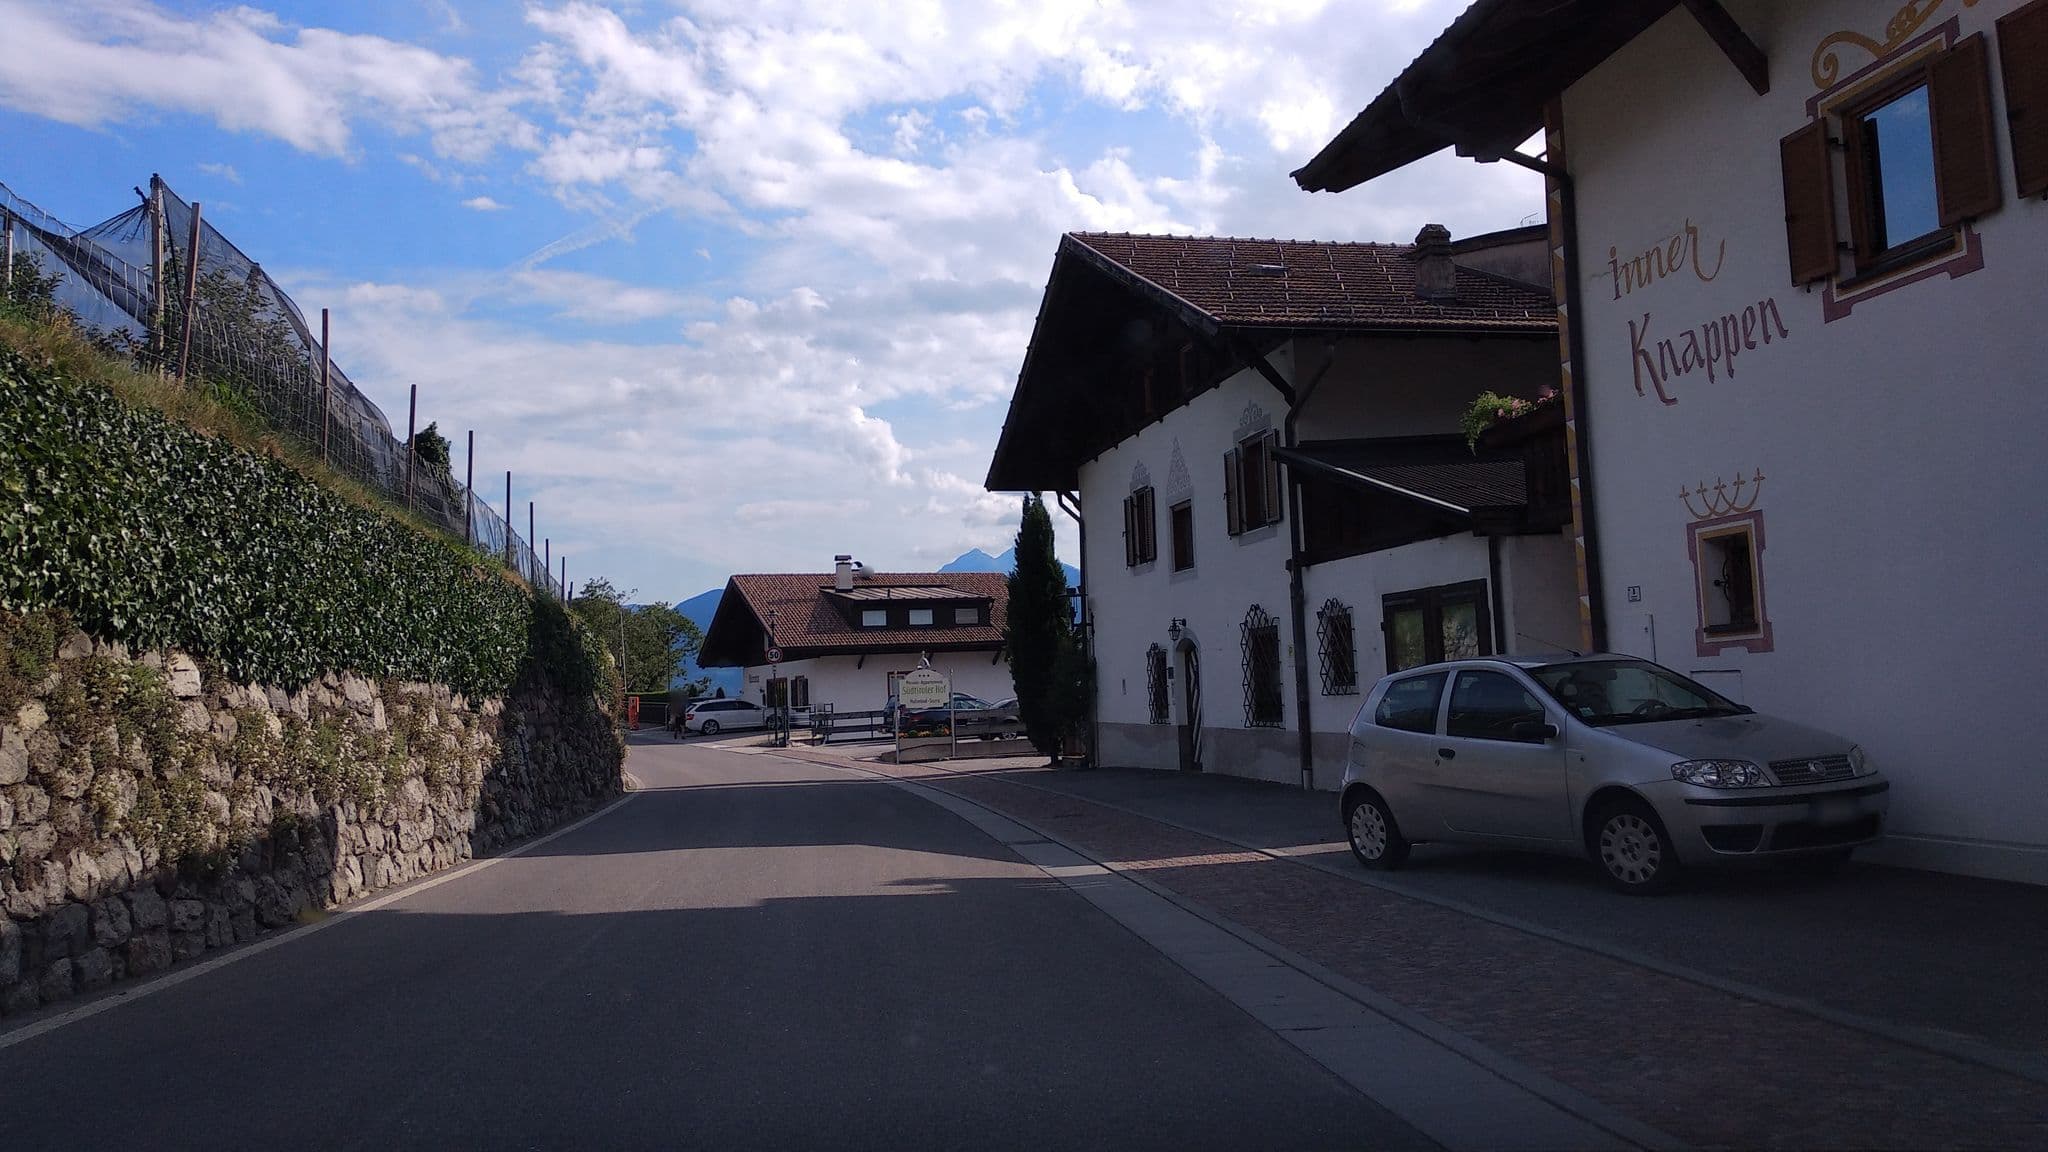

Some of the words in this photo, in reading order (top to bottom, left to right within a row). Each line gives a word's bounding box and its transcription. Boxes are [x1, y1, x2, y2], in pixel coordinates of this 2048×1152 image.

[1600, 217, 1725, 300] inner
[1628, 297, 1789, 406] Knappen
[769, 651, 779, 659] 50
